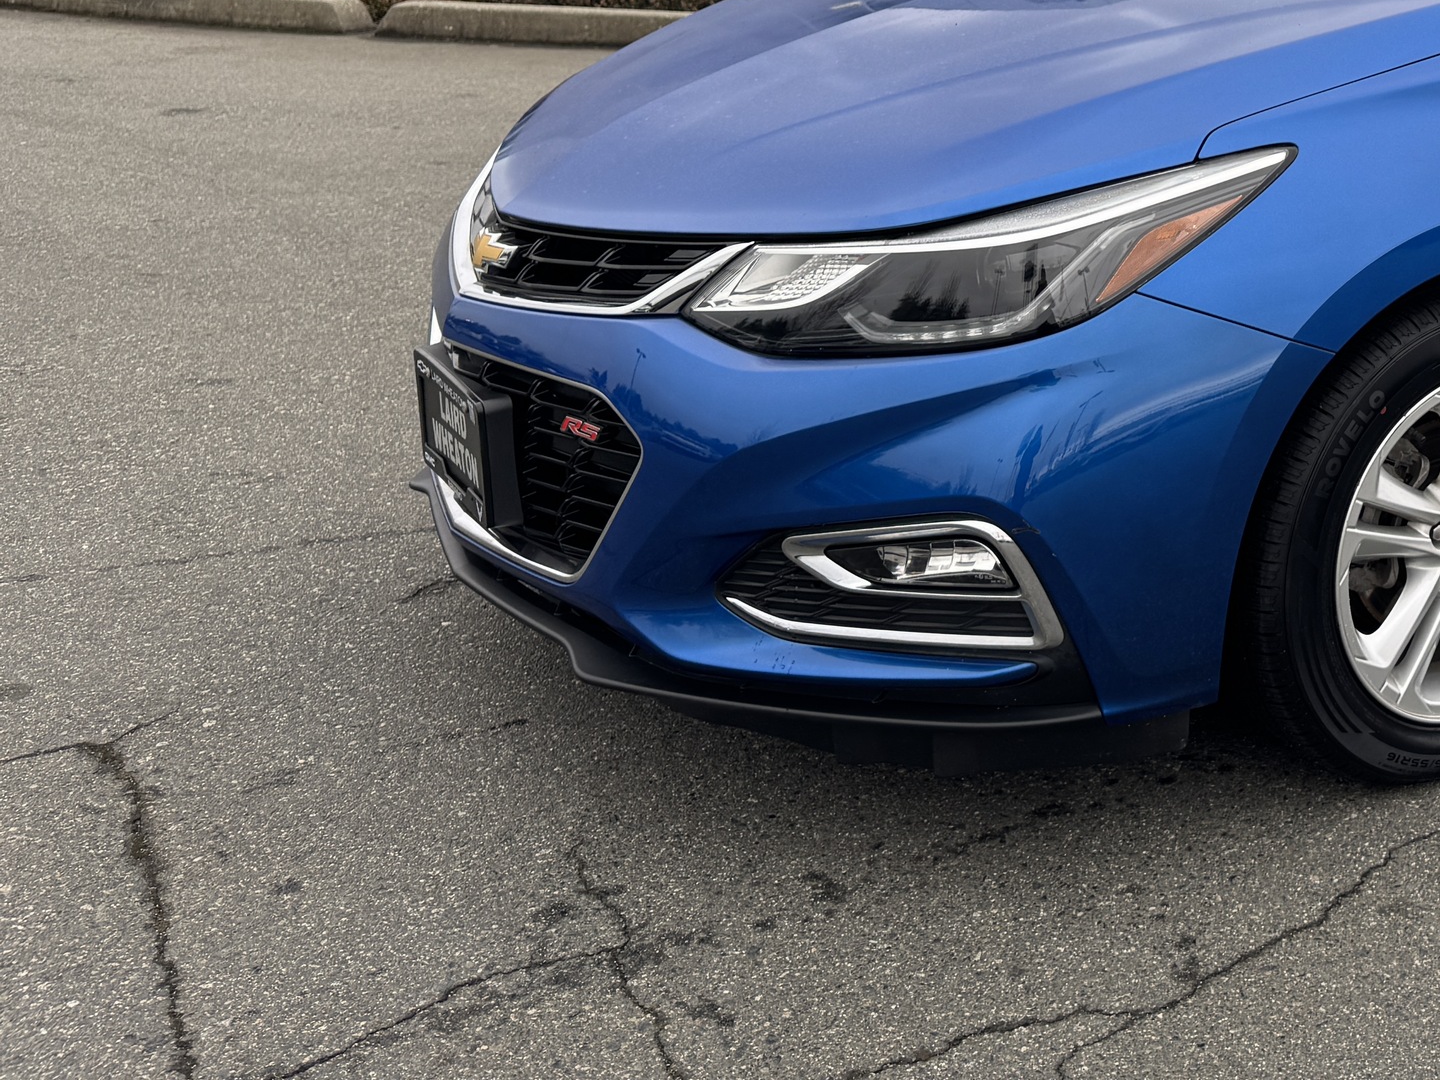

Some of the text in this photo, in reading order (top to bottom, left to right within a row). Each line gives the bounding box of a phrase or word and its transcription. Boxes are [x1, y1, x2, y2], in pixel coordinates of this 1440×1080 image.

[438, 391, 467, 440] LAIRD
[560, 415, 601, 441] RS
[1317, 389, 1386, 499] ROVELO
[431, 417, 480, 489] WHEATON
